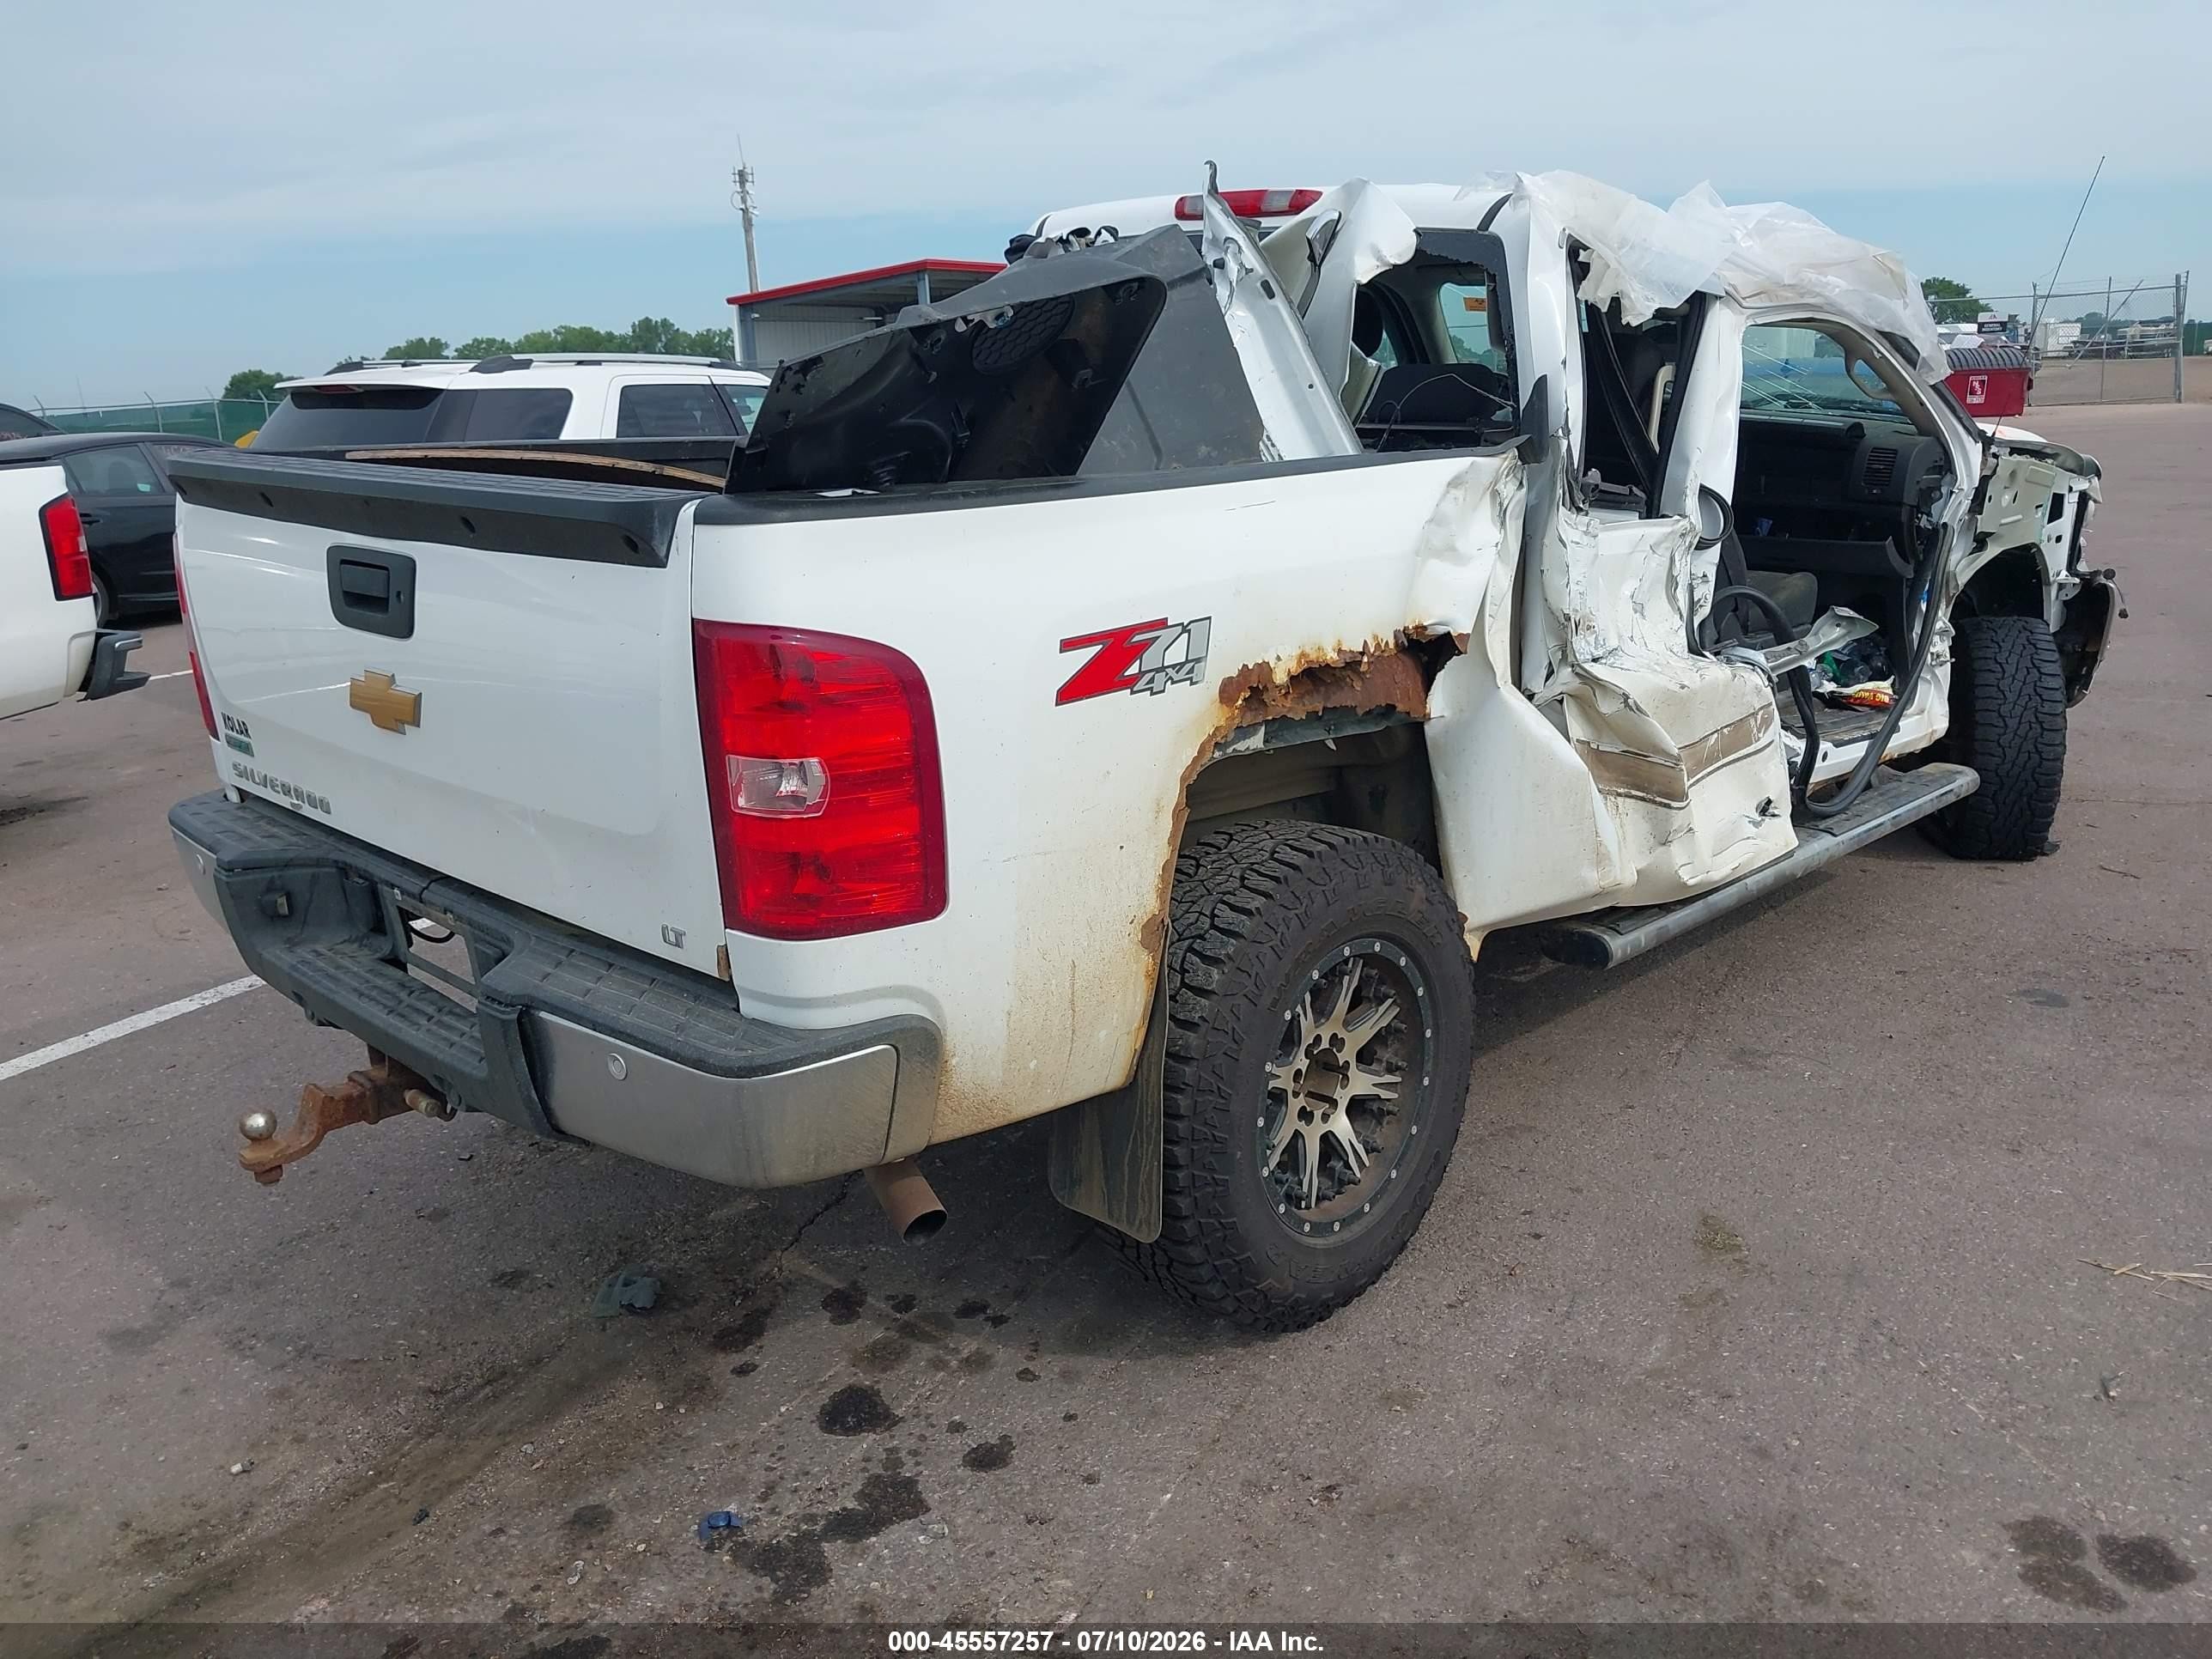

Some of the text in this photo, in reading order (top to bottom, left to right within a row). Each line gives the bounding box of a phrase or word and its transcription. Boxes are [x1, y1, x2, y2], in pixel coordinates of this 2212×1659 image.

[1055, 616, 1212, 707] Z71
[221, 712, 251, 739] KOLAR
[233, 762, 331, 814] SILVERADO
[661, 924, 686, 949] LT
